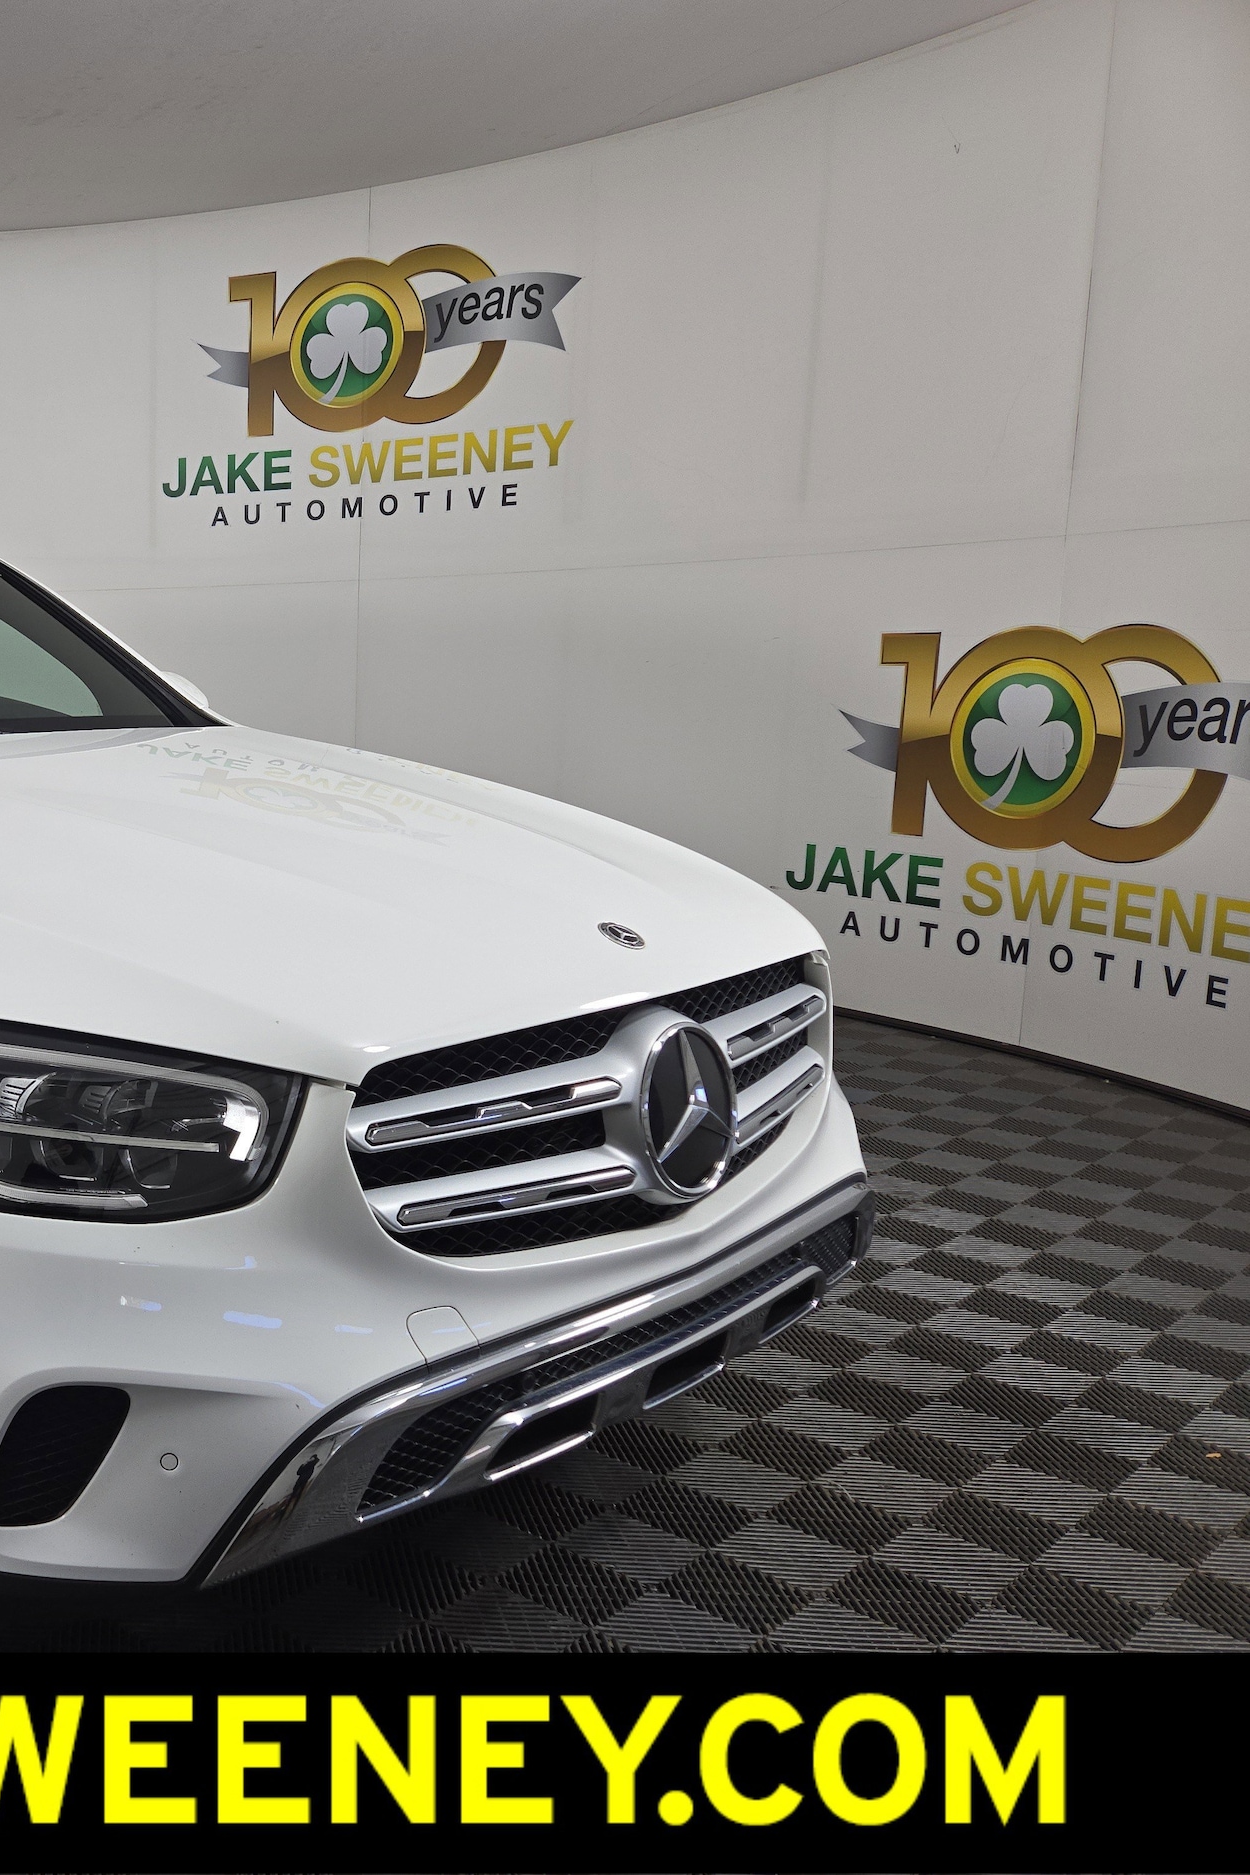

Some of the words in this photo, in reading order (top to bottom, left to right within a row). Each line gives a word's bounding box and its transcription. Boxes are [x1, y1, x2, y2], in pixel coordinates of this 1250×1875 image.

[228, 243, 507, 437] 100
[433, 282, 544, 343] years
[162, 449, 292, 498] JAKE
[308, 420, 575, 488] SWEENEY
[211, 483, 518, 527] AUTOMOTIVE
[880, 623, 1228, 863] 100
[1132, 697, 1250, 757] year
[786, 843, 944, 909] JAKE
[962, 861, 1250, 964] SWEENE
[840, 911, 1229, 1008] AUTOMOTIVE
